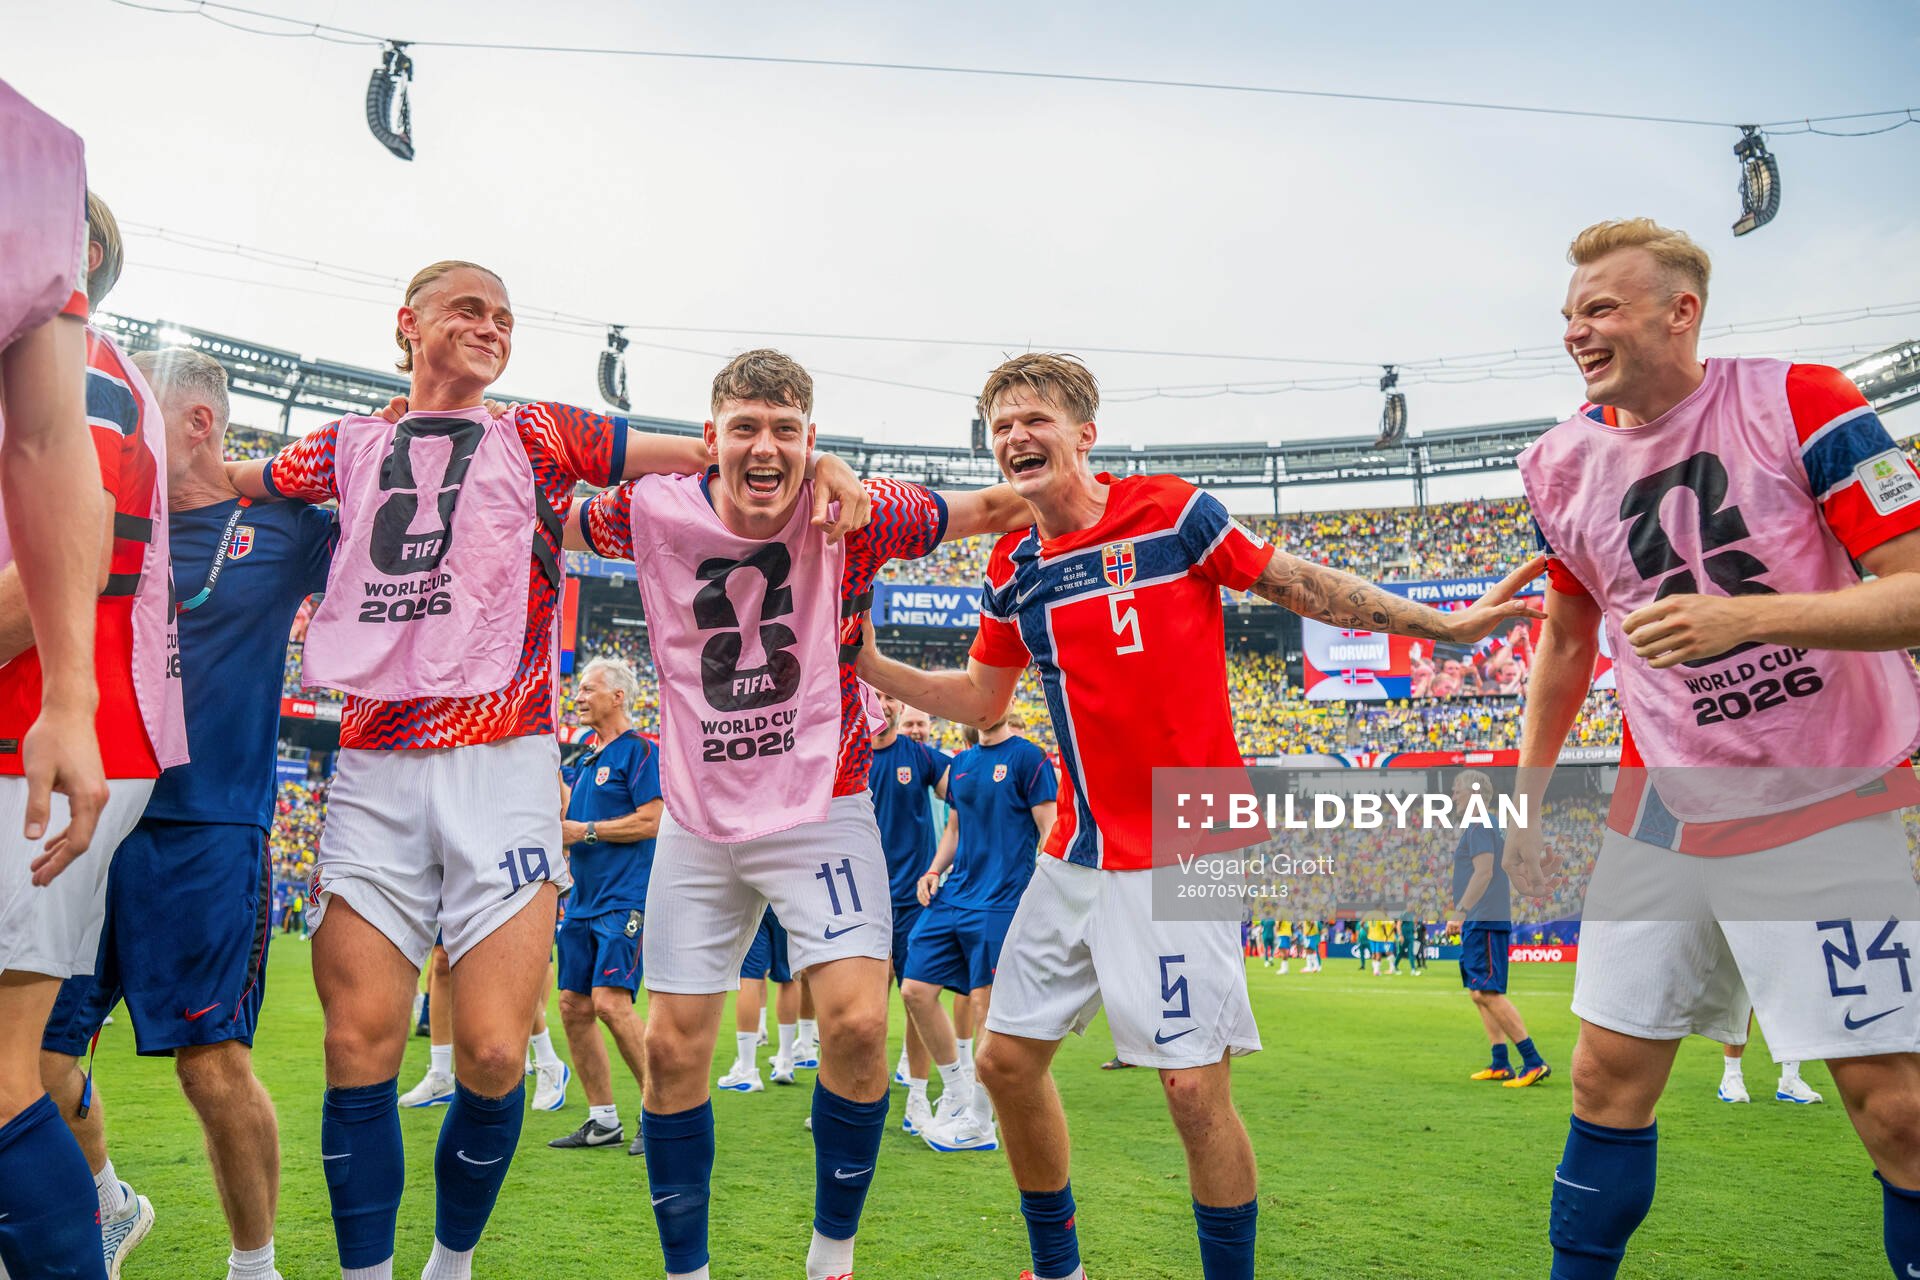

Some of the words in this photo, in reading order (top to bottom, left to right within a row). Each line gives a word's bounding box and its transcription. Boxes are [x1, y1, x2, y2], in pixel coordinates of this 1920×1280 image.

[1879, 482, 1915, 502] EDUCATION
[209, 566, 220, 583] FIFA
[215, 541, 229, 566] WORLD
[223, 526, 233, 541] CUP
[892, 591, 961, 610] NEW
[1407, 585, 1441, 601] FIFA
[891, 610, 948, 626] NEW
[1107, 590, 1145, 656] 5
[1328, 643, 1385, 662] NORWAY
[732, 673, 776, 697] FIFA
[1684, 663, 1756, 695] WORLD
[1759, 647, 1810, 672] CUP
[1692, 666, 1825, 727] 2026
[701, 716, 768, 735] WORLD
[702, 727, 796, 763] 2026
[1558, 750, 1584, 761] ORLD
[1584, 749, 1605, 760] CUP
[498, 847, 551, 901] 19
[815, 858, 863, 916] 11
[1815, 914, 1913, 997] 24
[1159, 954, 1191, 1019] 5
